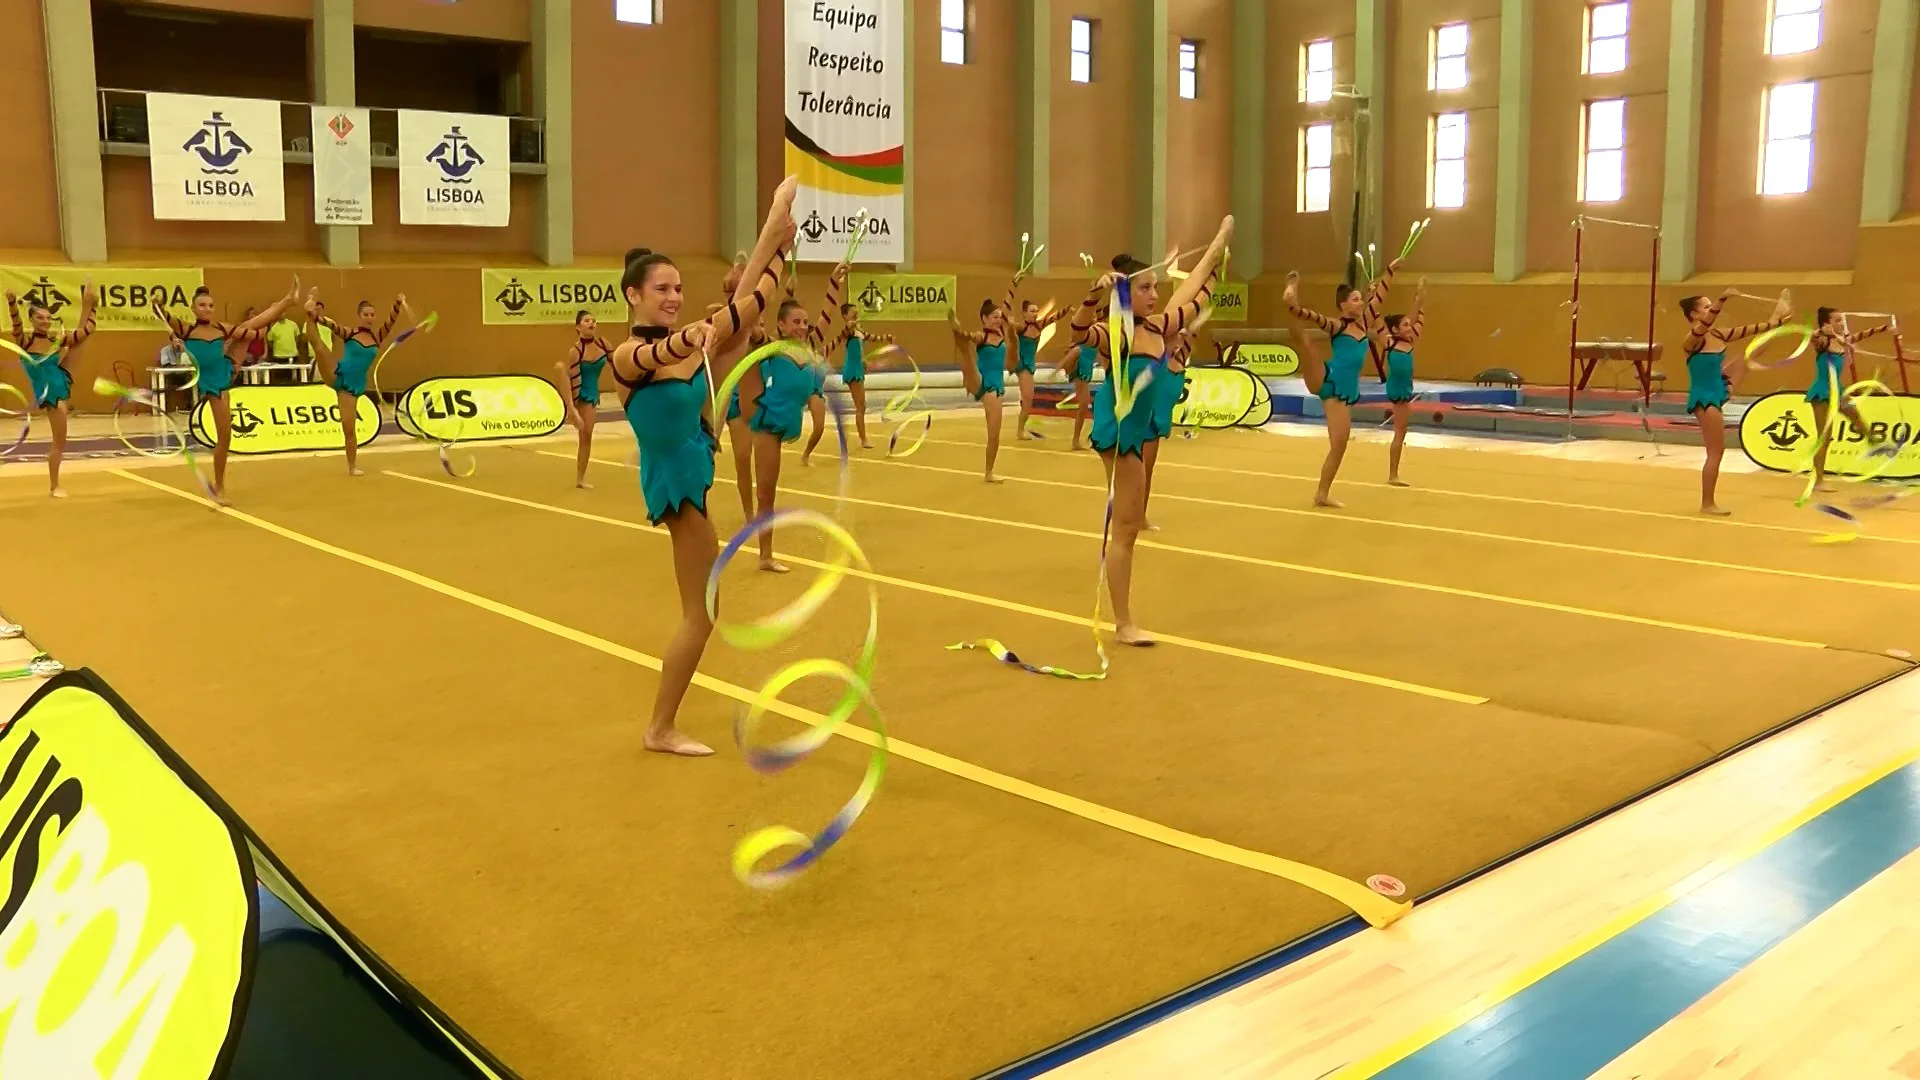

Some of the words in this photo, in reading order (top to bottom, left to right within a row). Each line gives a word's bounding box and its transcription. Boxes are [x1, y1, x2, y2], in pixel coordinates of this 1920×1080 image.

[813, 2, 877, 33] Equipa
[808, 46, 884, 76] Respeito
[798, 91, 891, 119] Tolerância
[185, 180, 254, 197] LISBOA
[427, 188, 484, 204] LISBOA
[832, 216, 890, 235] LISOA
[539, 284, 617, 303] LISBOA
[890, 286, 947, 304] LISBOA
[1251, 353, 1292, 363] LISBOA
[423, 386, 551, 419] LISBOA
[481, 421, 502, 431] Viva
[504, 421, 511, 430] o
[512, 418, 556, 431] Desporto
